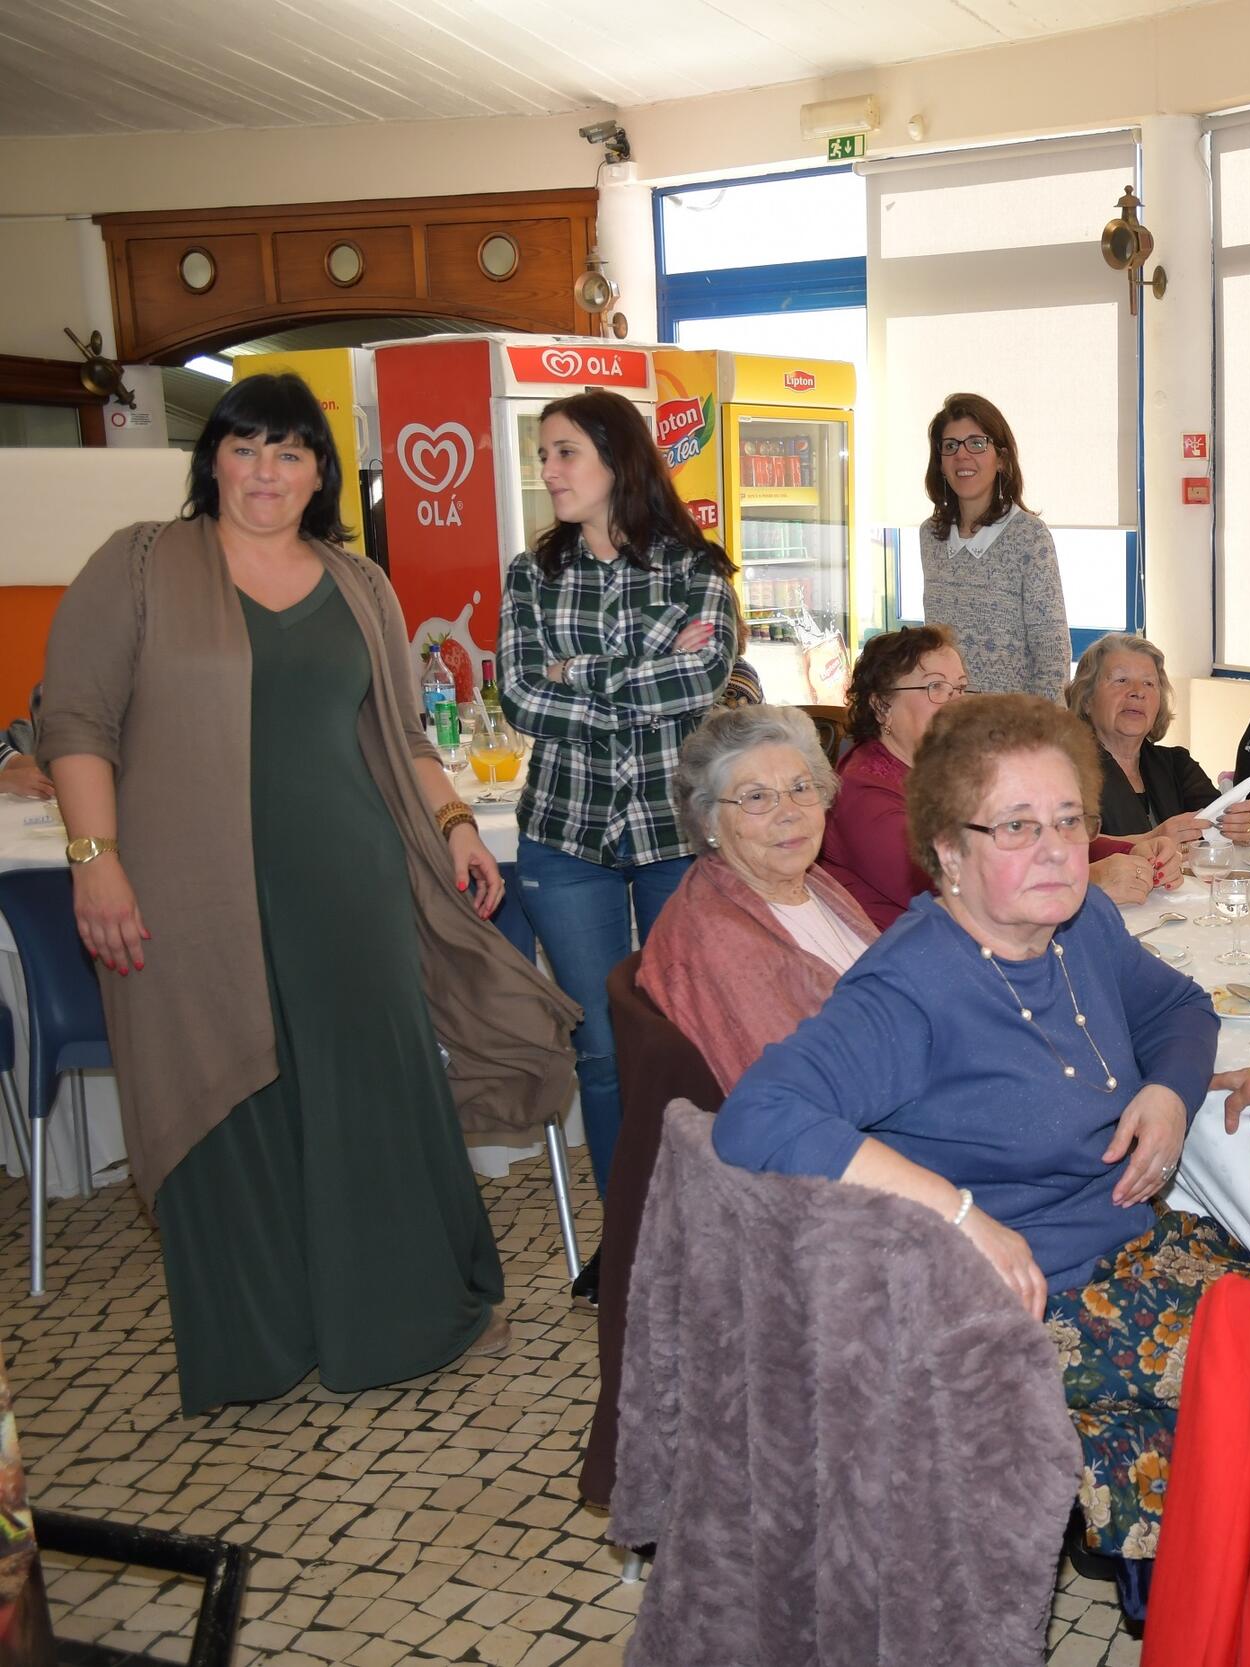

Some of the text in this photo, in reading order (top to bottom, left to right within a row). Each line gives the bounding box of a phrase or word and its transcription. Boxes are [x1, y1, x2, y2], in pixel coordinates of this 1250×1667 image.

[587, 355, 623, 376] OLÁ
[786, 374, 814, 387] Lipton
[656, 408, 698, 440] pton
[674, 437, 700, 462] Tea
